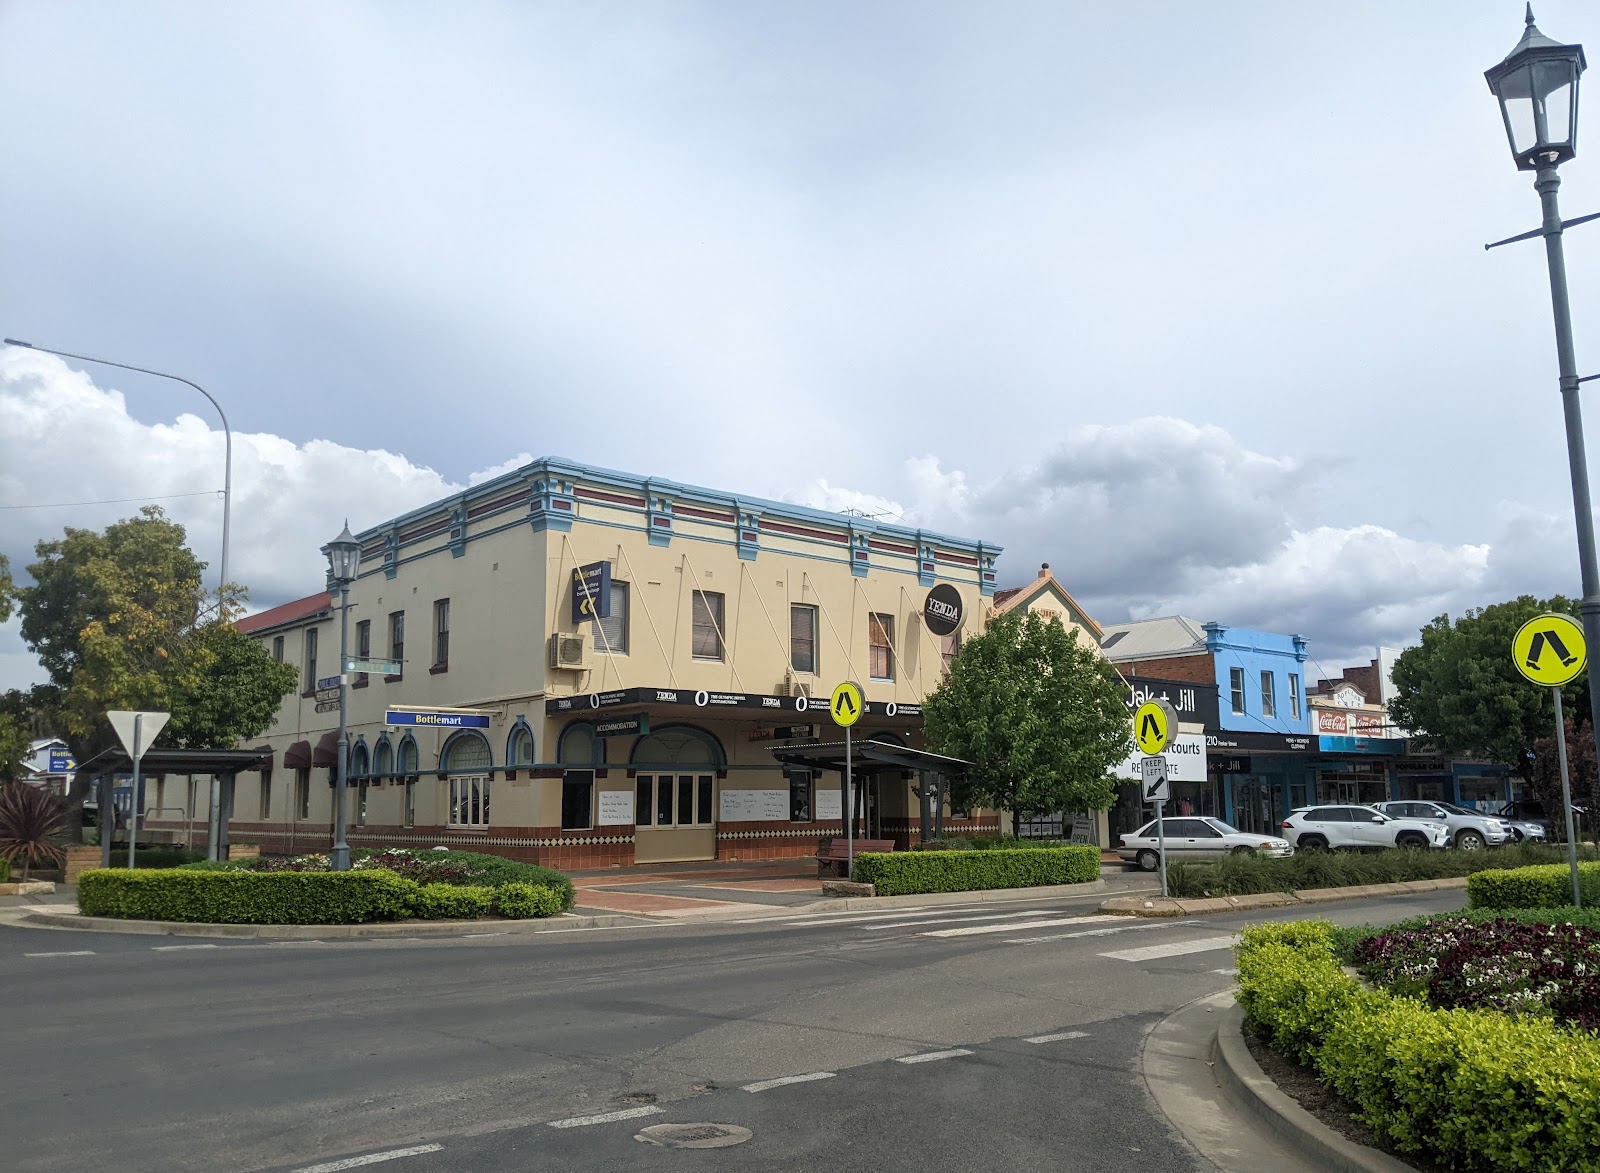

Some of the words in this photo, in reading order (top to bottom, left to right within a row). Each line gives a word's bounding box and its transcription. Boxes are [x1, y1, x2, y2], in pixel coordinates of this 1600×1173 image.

[928, 598, 959, 620] YENDA
[657, 691, 677, 700] YENDA
[1175, 689, 1196, 712] Jill
[1337, 689, 1362, 702] POPULAR
[762, 697, 781, 706] YENDA
[415, 714, 462, 725] Bottlemart
[596, 721, 638, 732] ACCOMMODATION
[1206, 735, 1218, 747] 210
[1145, 759, 1162, 767] KEEP
[1227, 760, 1241, 771] Jill
[1395, 762, 1427, 770] POPULAR
[1428, 762, 1445, 770] CAFE
[1146, 768, 1162, 776] LEFT
[1072, 833, 1088, 844] OPEN
